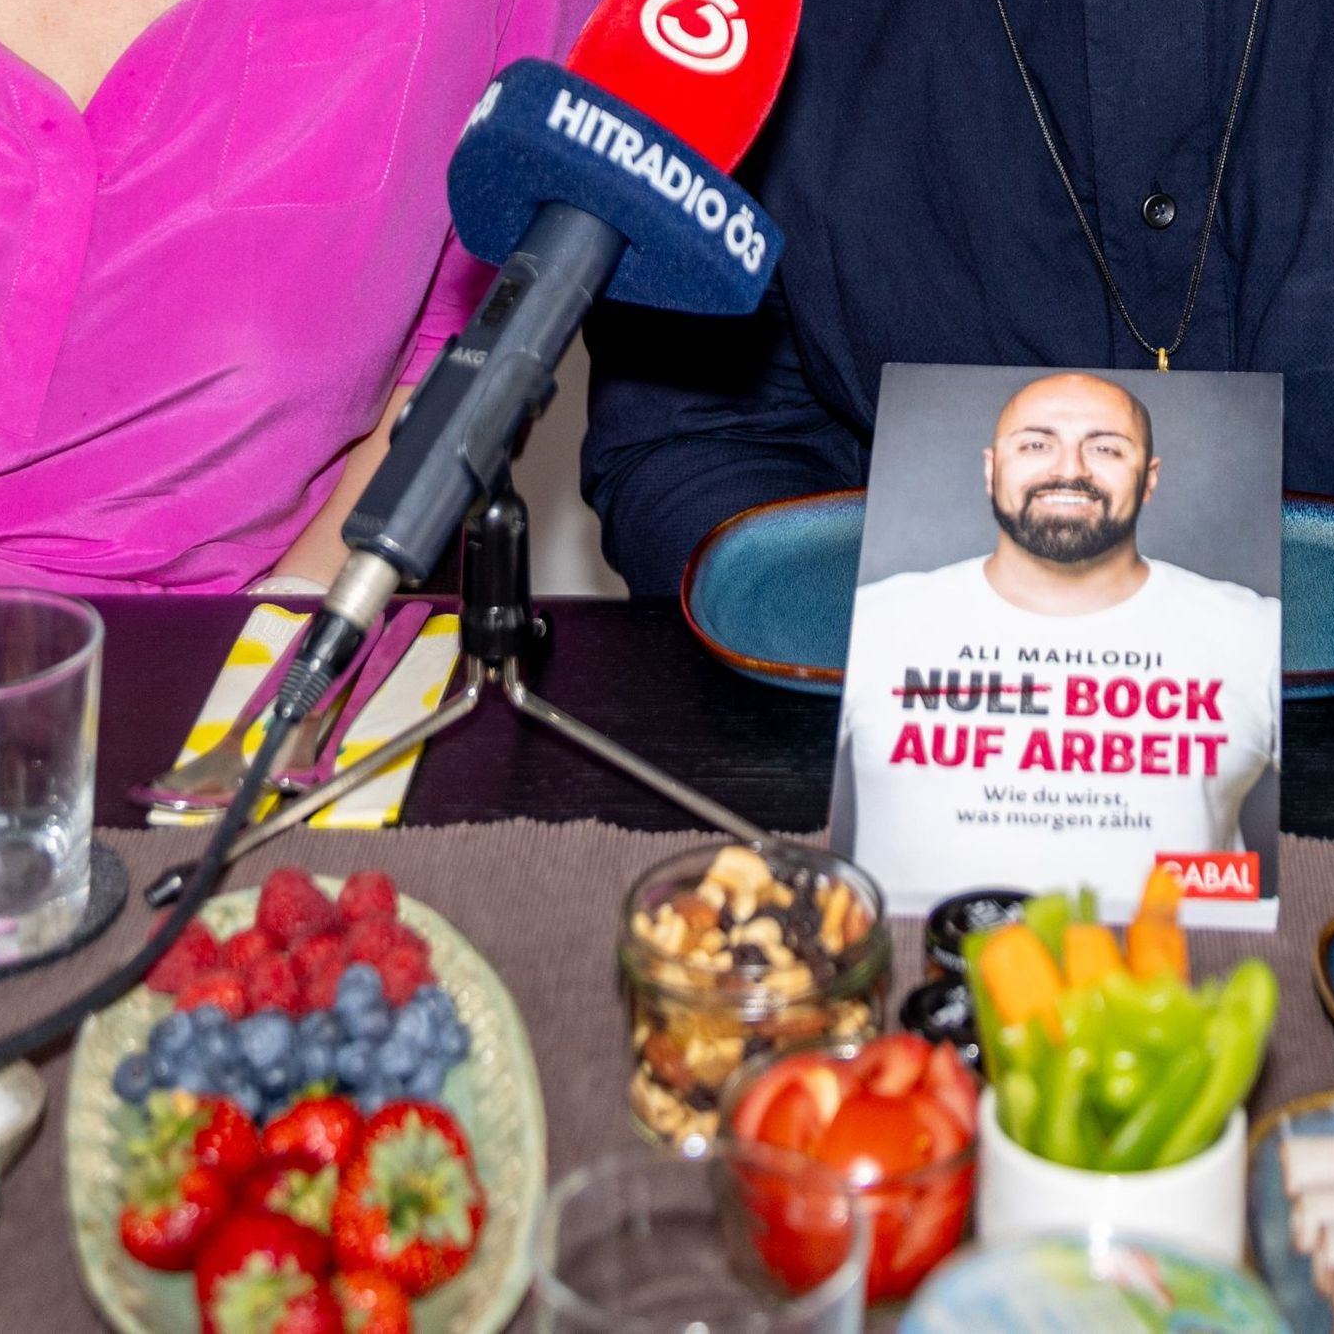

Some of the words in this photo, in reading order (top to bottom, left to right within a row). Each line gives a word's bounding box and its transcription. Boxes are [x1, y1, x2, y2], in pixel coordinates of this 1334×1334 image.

[546, 88, 728, 231] HITRADIO
[724, 203, 766, 275] Ö3
[449, 346, 488, 365] AKG
[958, 645, 1000, 661] ALI
[1018, 646, 1163, 670] MAHLODJI
[901, 666, 1050, 716] NULL
[1064, 674, 1224, 722] BOCK
[889, 721, 1006, 768] AUF
[1018, 727, 1229, 778] ARBEIT
[983, 785, 1027, 803] Wie
[1033, 787, 1060, 804] du
[1066, 788, 1130, 808] wirst,
[956, 809, 1002, 825] was
[1006, 812, 1093, 830] morgen
[1098, 809, 1152, 830] zählt
